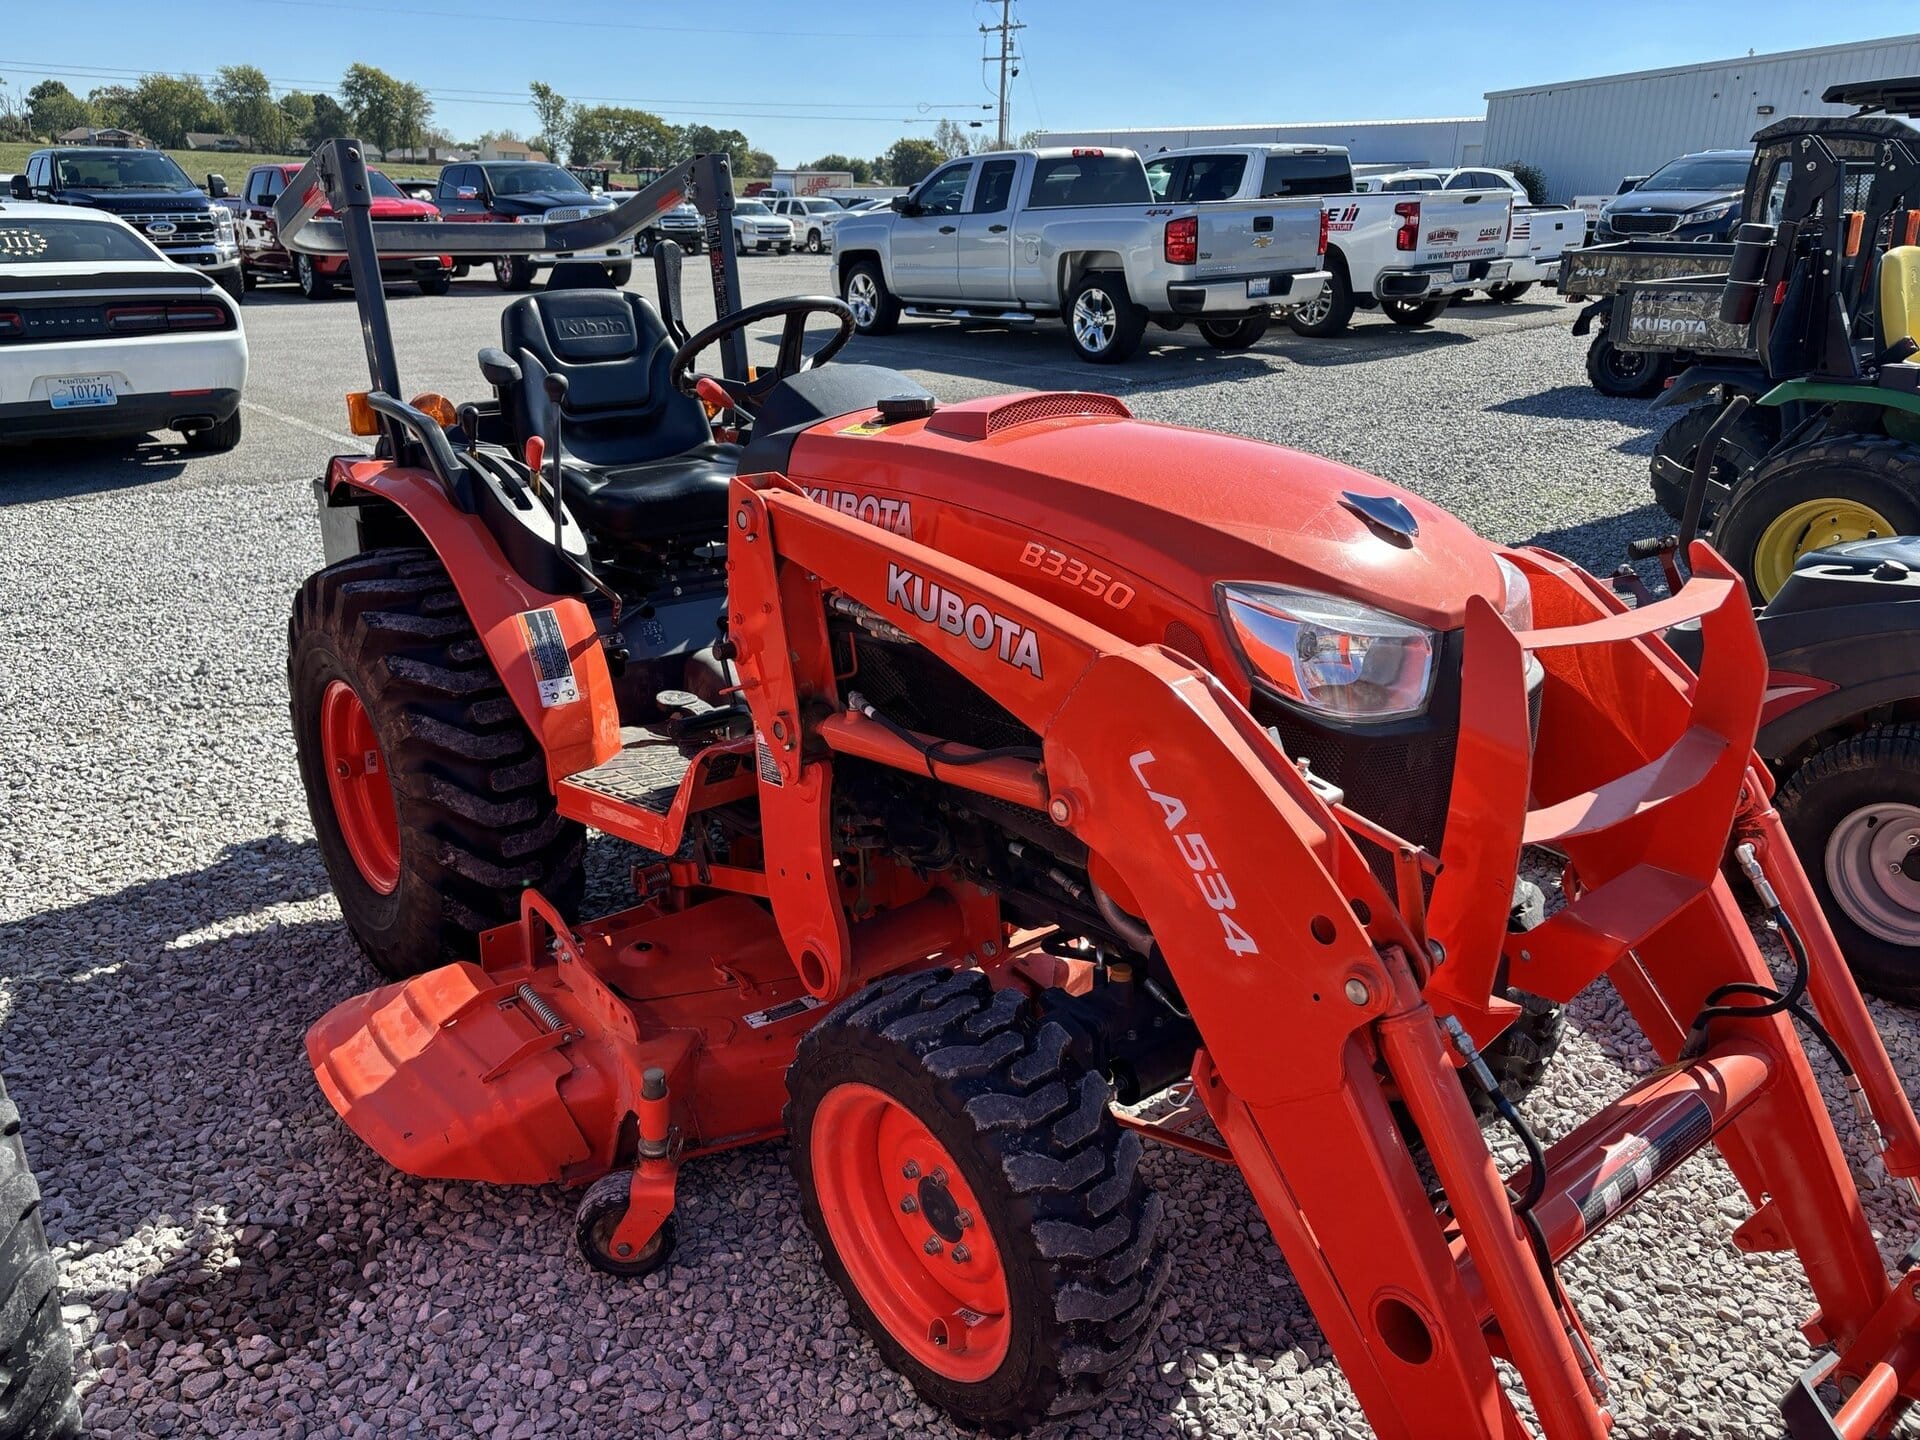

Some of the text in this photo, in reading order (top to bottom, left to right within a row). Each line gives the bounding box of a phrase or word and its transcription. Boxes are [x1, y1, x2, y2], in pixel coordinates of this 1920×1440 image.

[807, 176, 831, 186] LUBE
[1480, 227, 1496, 236] CASE
[1427, 247, 1496, 260] www.hragripower.com
[561, 318, 626, 335] Kubota
[1631, 317, 1707, 334] KUBOTA
[1020, 541, 1136, 611] B3350
[886, 562, 1045, 679] KUBOTA
[1129, 750, 1260, 957] LA534
